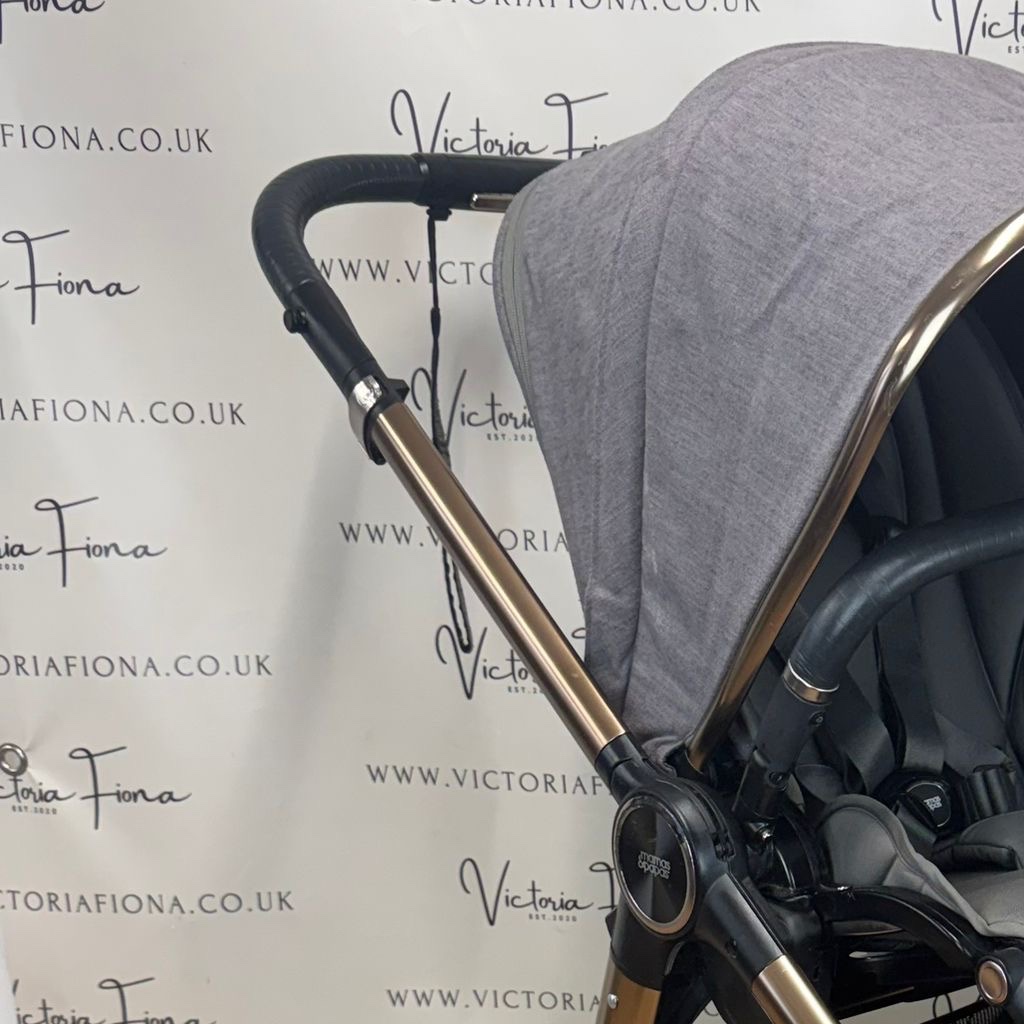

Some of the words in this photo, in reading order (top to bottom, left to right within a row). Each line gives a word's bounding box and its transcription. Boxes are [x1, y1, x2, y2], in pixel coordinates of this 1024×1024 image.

[391, 88, 548, 157] Victoria
[2, 229, 140, 325] Fiona
[35, 496, 168, 588] Fiona
[68, 746, 193, 831] Fiona
[459, 857, 594, 927] Victoria
